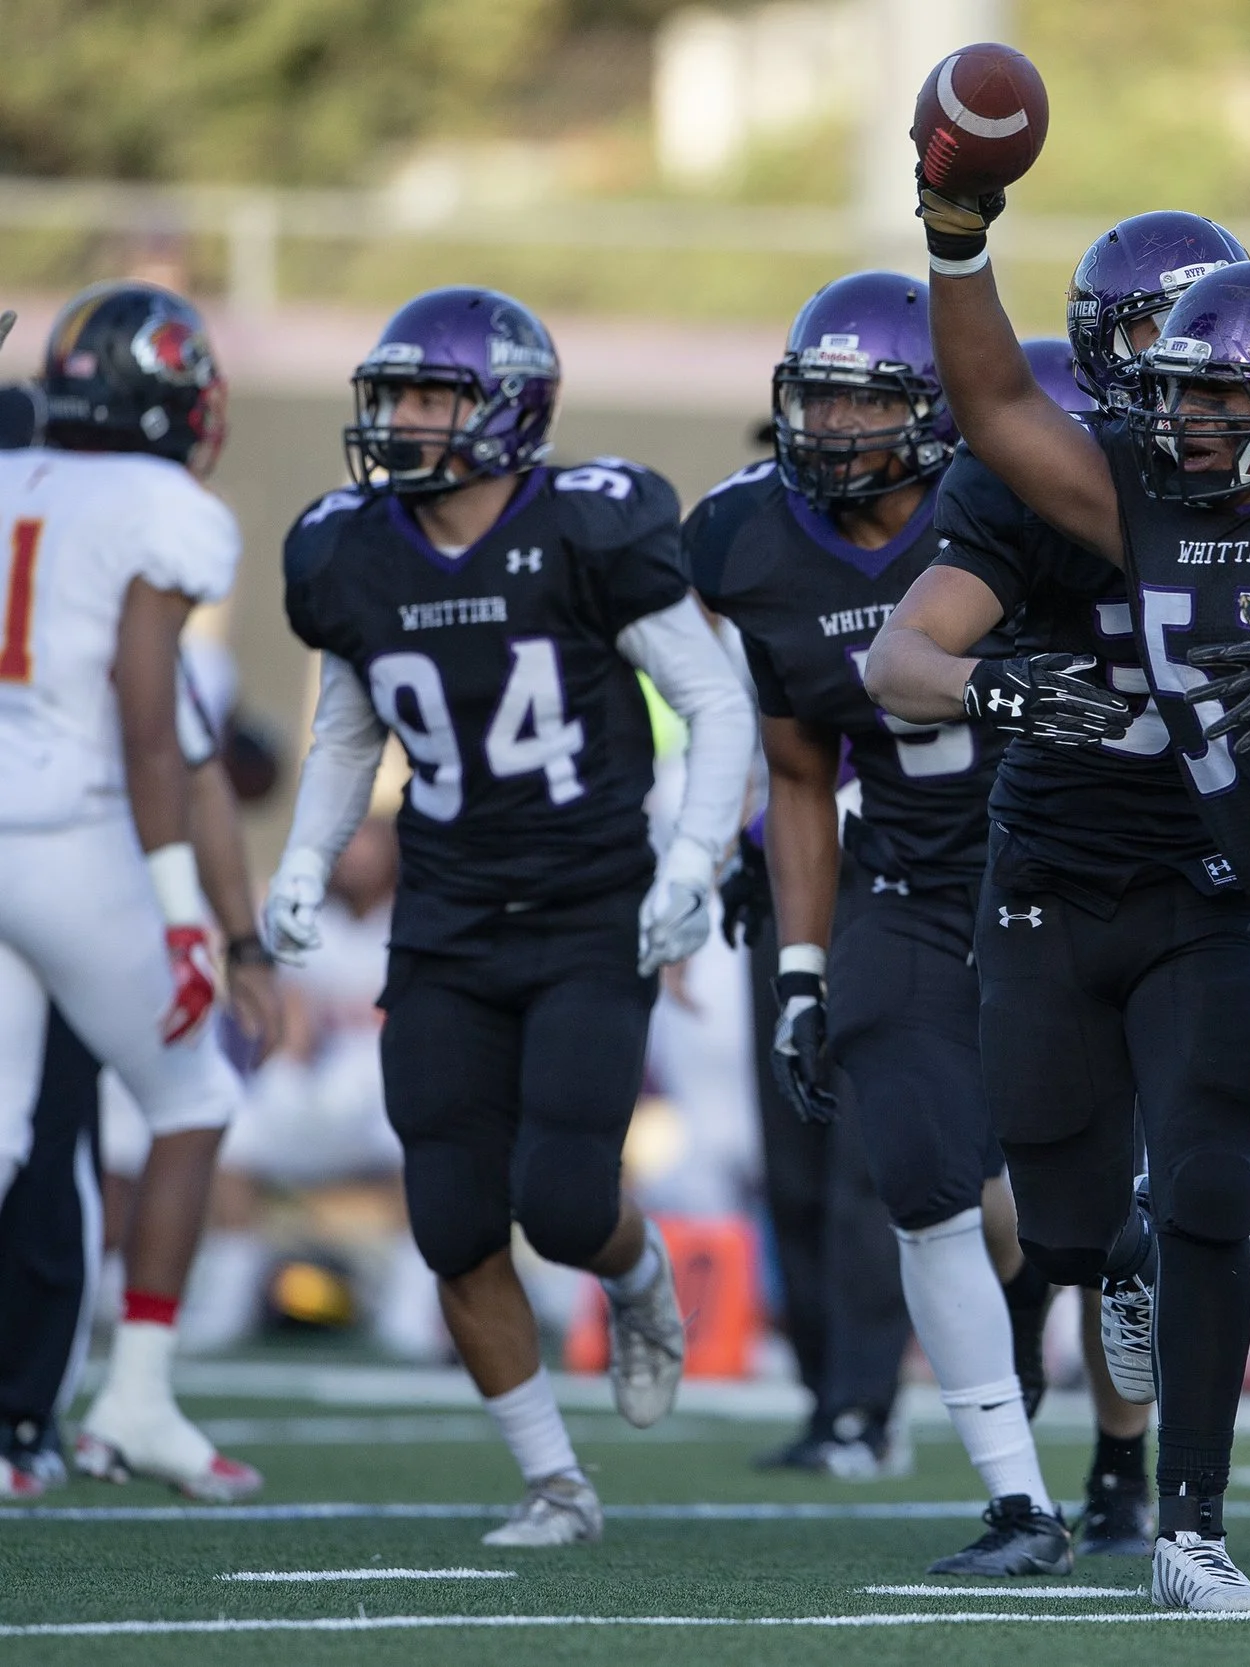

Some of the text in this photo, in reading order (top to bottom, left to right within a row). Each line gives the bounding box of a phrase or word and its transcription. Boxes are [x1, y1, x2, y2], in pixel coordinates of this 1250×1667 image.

[1184, 266, 1206, 279] RYFP
[398, 596, 508, 631] WHITTIER
[817, 602, 898, 637] WHITT
[368, 637, 586, 823] 94
